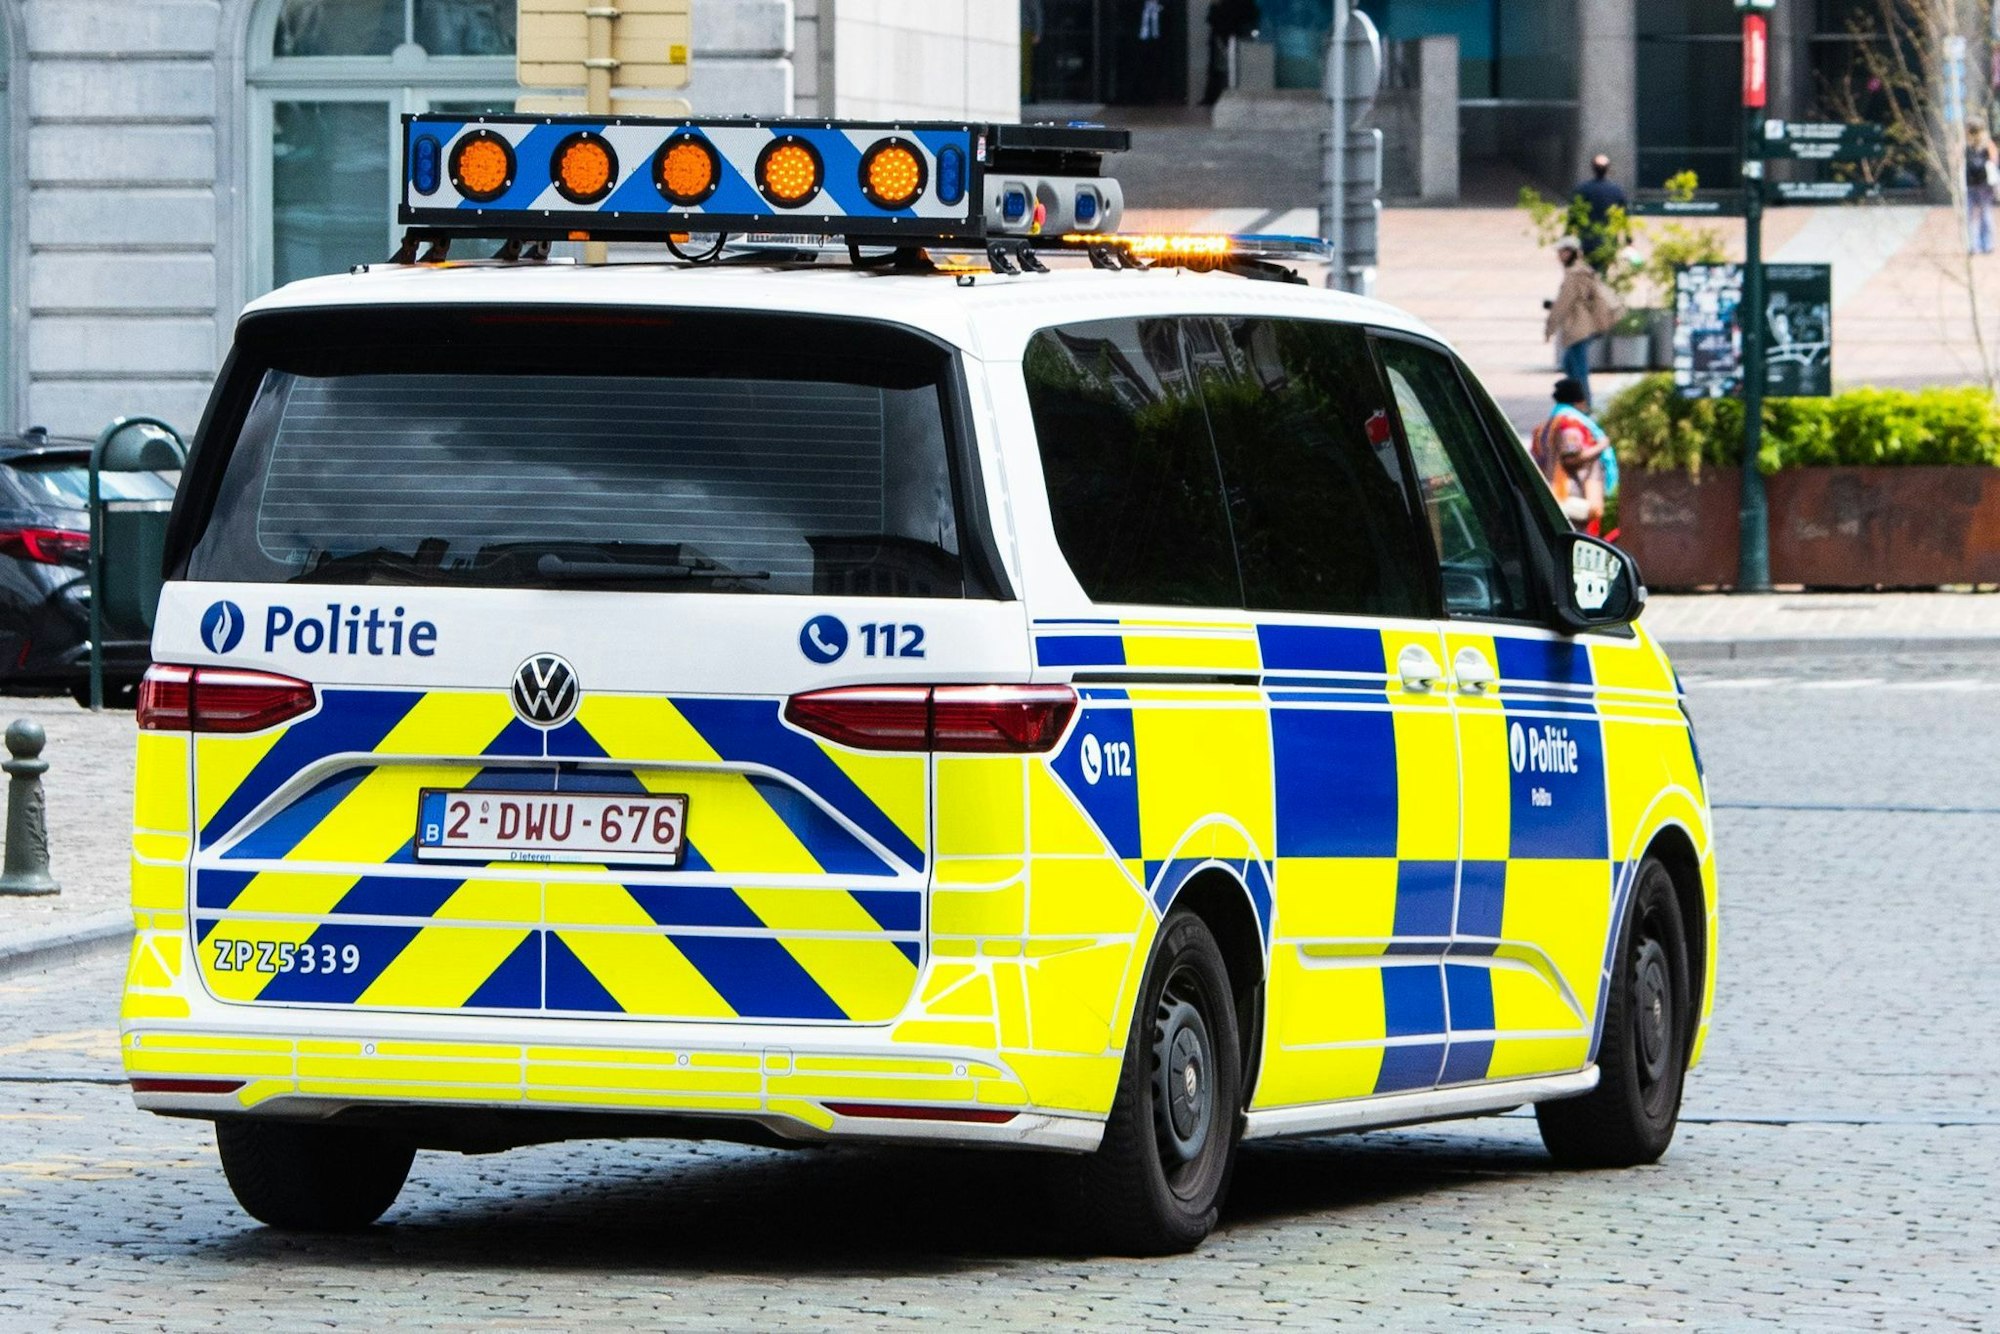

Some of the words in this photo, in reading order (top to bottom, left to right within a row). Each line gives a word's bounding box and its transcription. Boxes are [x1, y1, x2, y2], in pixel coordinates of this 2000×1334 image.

[264, 603, 438, 656] Politie
[860, 623, 926, 658] 112
[1103, 741, 1132, 777] 112
[1528, 724, 1579, 774] Politie
[425, 823, 440, 842] B
[213, 939, 361, 975] ZPZ5339
